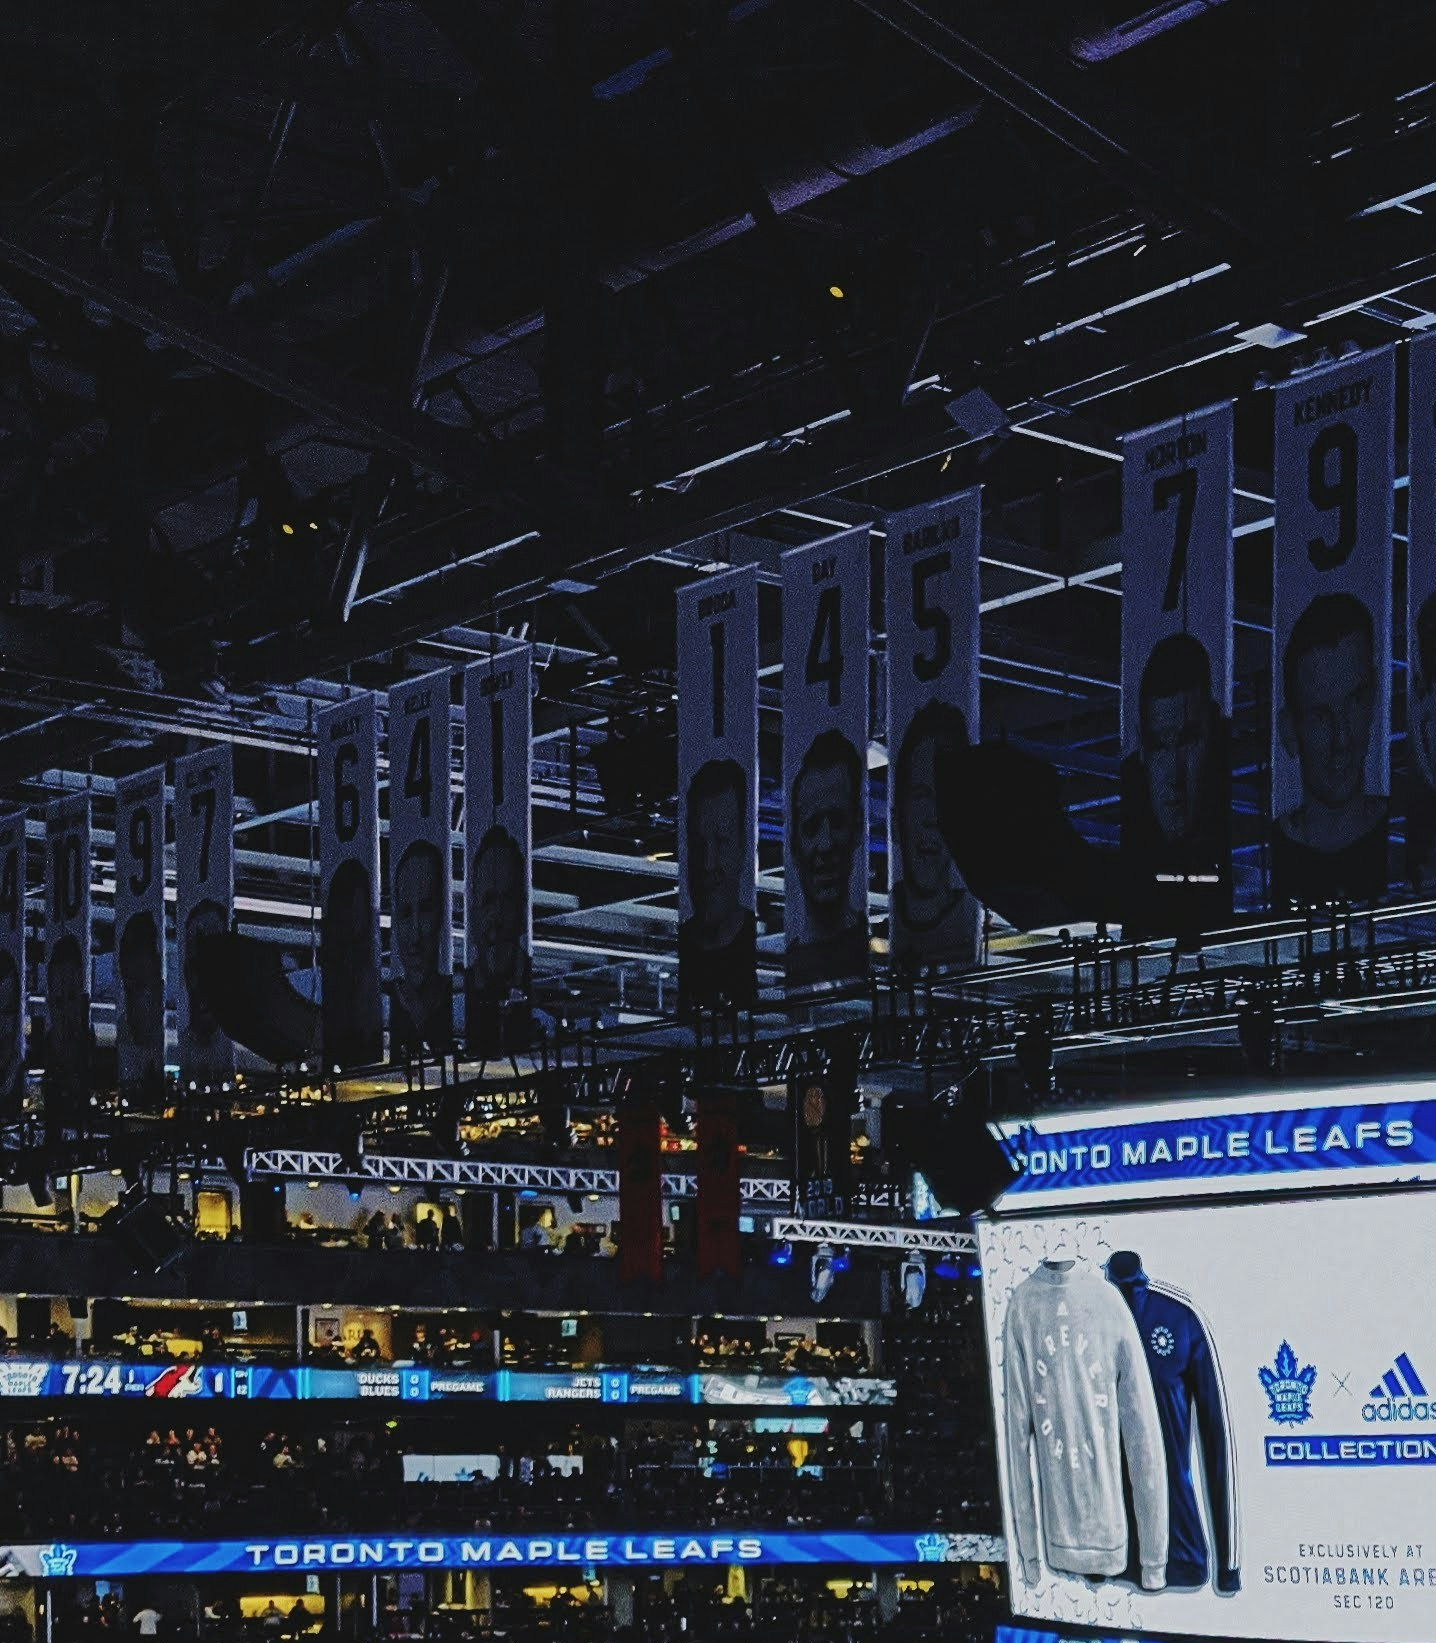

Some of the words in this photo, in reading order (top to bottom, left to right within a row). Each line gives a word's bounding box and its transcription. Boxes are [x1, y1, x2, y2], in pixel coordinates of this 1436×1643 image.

[1295, 378, 1373, 426] KENNEDY
[1307, 423, 1358, 572] 9
[1153, 467, 1198, 610] 7
[812, 557, 836, 585] DAY
[912, 551, 951, 682] 5
[805, 585, 841, 707] 4
[711, 621, 725, 737] 1
[405, 716, 432, 817] 4
[491, 700, 504, 806] 1
[335, 743, 361, 842] 6
[190, 788, 216, 883] 7
[129, 807, 152, 897] 9
[1011, 1143, 1110, 1176] ONTO
[1122, 1131, 1249, 1164] MAPLE
[1265, 1120, 1414, 1156] LEAFS
[62, 1365, 122, 1394] 7:24
[214, 1372, 224, 1393] 1
[359, 1373, 399, 1385] DUCKS
[360, 1386, 399, 1397] BLUES
[430, 1381, 484, 1393] PREGAME
[545, 1387, 601, 1399] RANGERS
[573, 1377, 601, 1388] JETS
[630, 1384, 681, 1396] PREGAME
[245, 1543, 445, 1566] TORONTO
[461, 1539, 609, 1563] MAPLE
[625, 1538, 762, 1560] LEAFS
[1299, 1544, 1399, 1559] EXCLUSIVELY
[1406, 1544, 1424, 1558] AT
[1264, 1565, 1390, 1587] SCOTIABANK
[1333, 1594, 1362, 1609] SEC
[1367, 1595, 1395, 1610] 120
